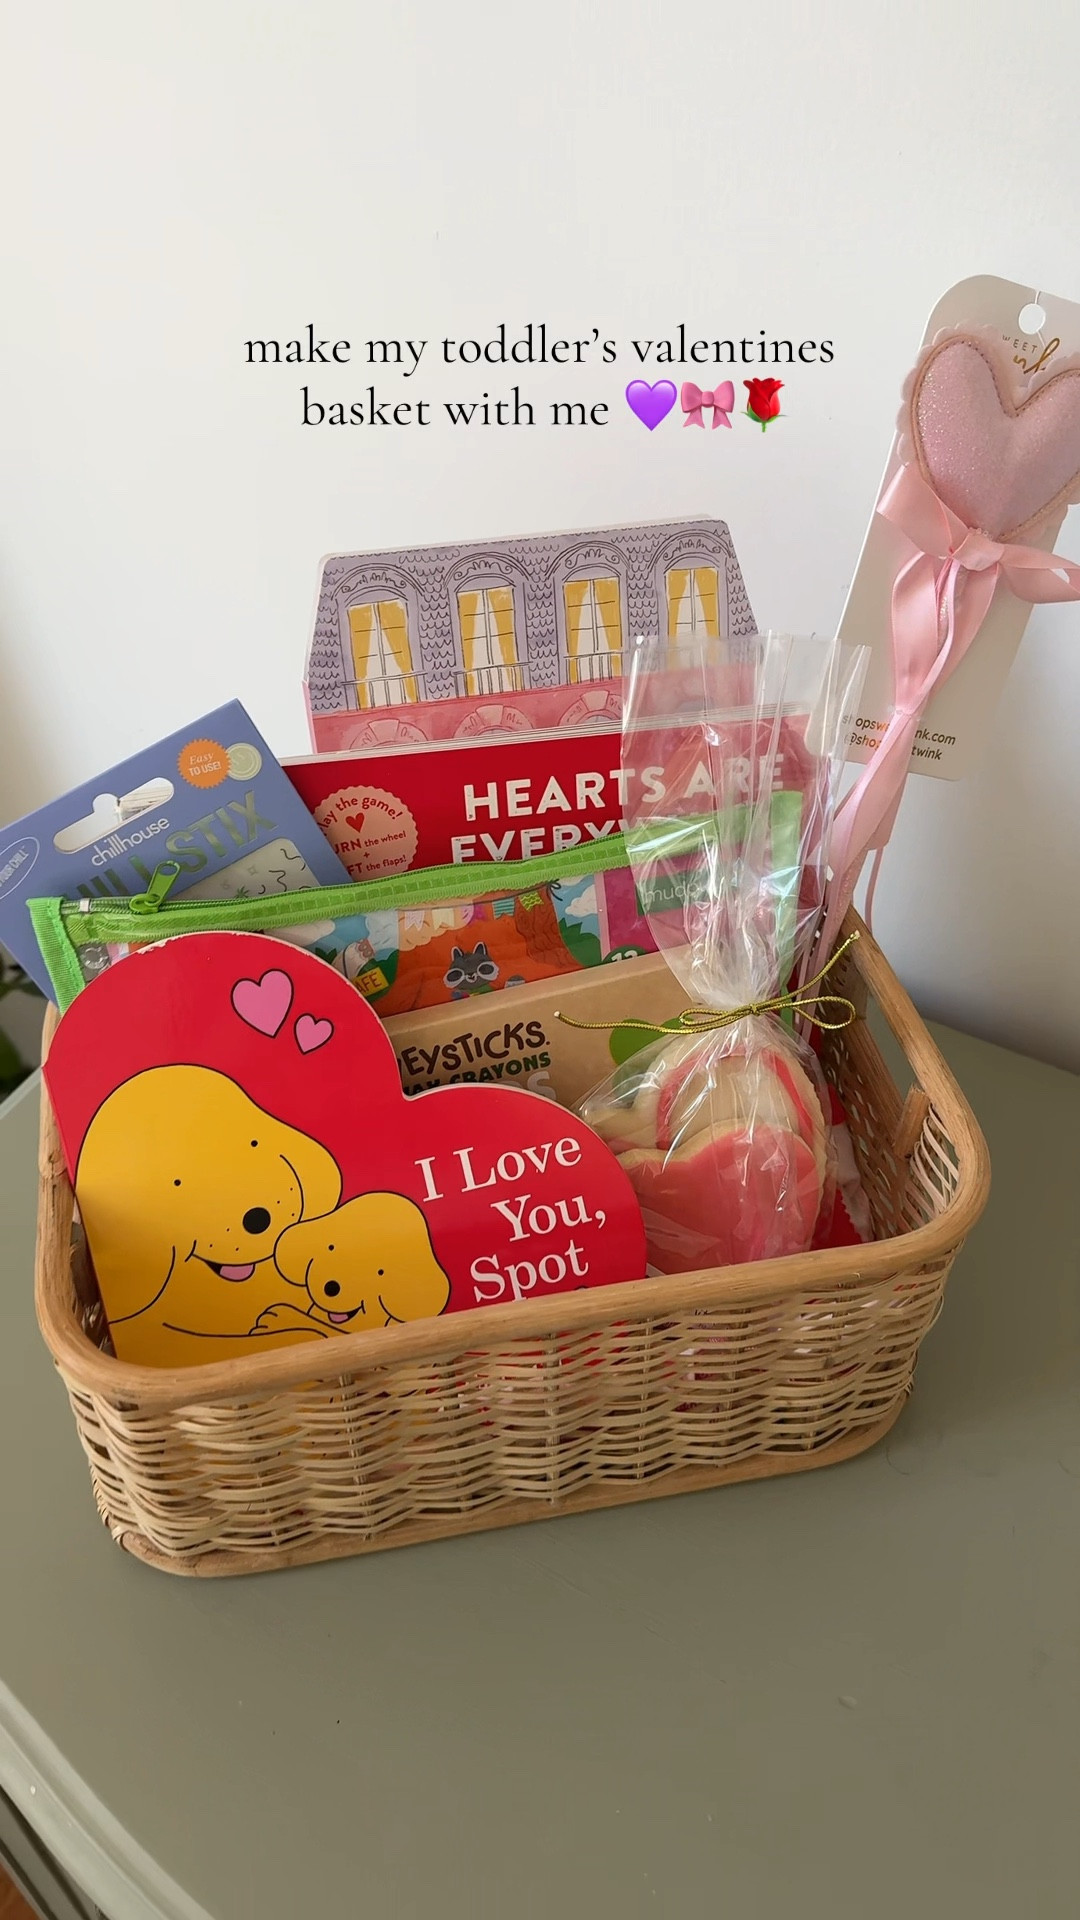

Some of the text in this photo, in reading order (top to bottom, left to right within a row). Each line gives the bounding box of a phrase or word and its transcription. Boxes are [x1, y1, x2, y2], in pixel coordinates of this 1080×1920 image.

[188, 761, 222, 777] TO USE!
[189, 752, 214, 765] Easy
[463, 753, 784, 822] HEARTS ARE
[91, 816, 170, 867] chillhouse
[165, 790, 279, 874] STIX
[317, 797, 403, 837] lay the game!
[364, 839, 379, 847] the
[381, 830, 407, 843] wheel
[347, 854, 407, 876] FT the flaps!
[399, 1020, 551, 1076] EYSTICKS.
[450, 1051, 552, 1084] CRAYONS
[414, 1136, 583, 1203] I Love
[490, 1194, 606, 1243] You,
[469, 1239, 589, 1303] Spot
